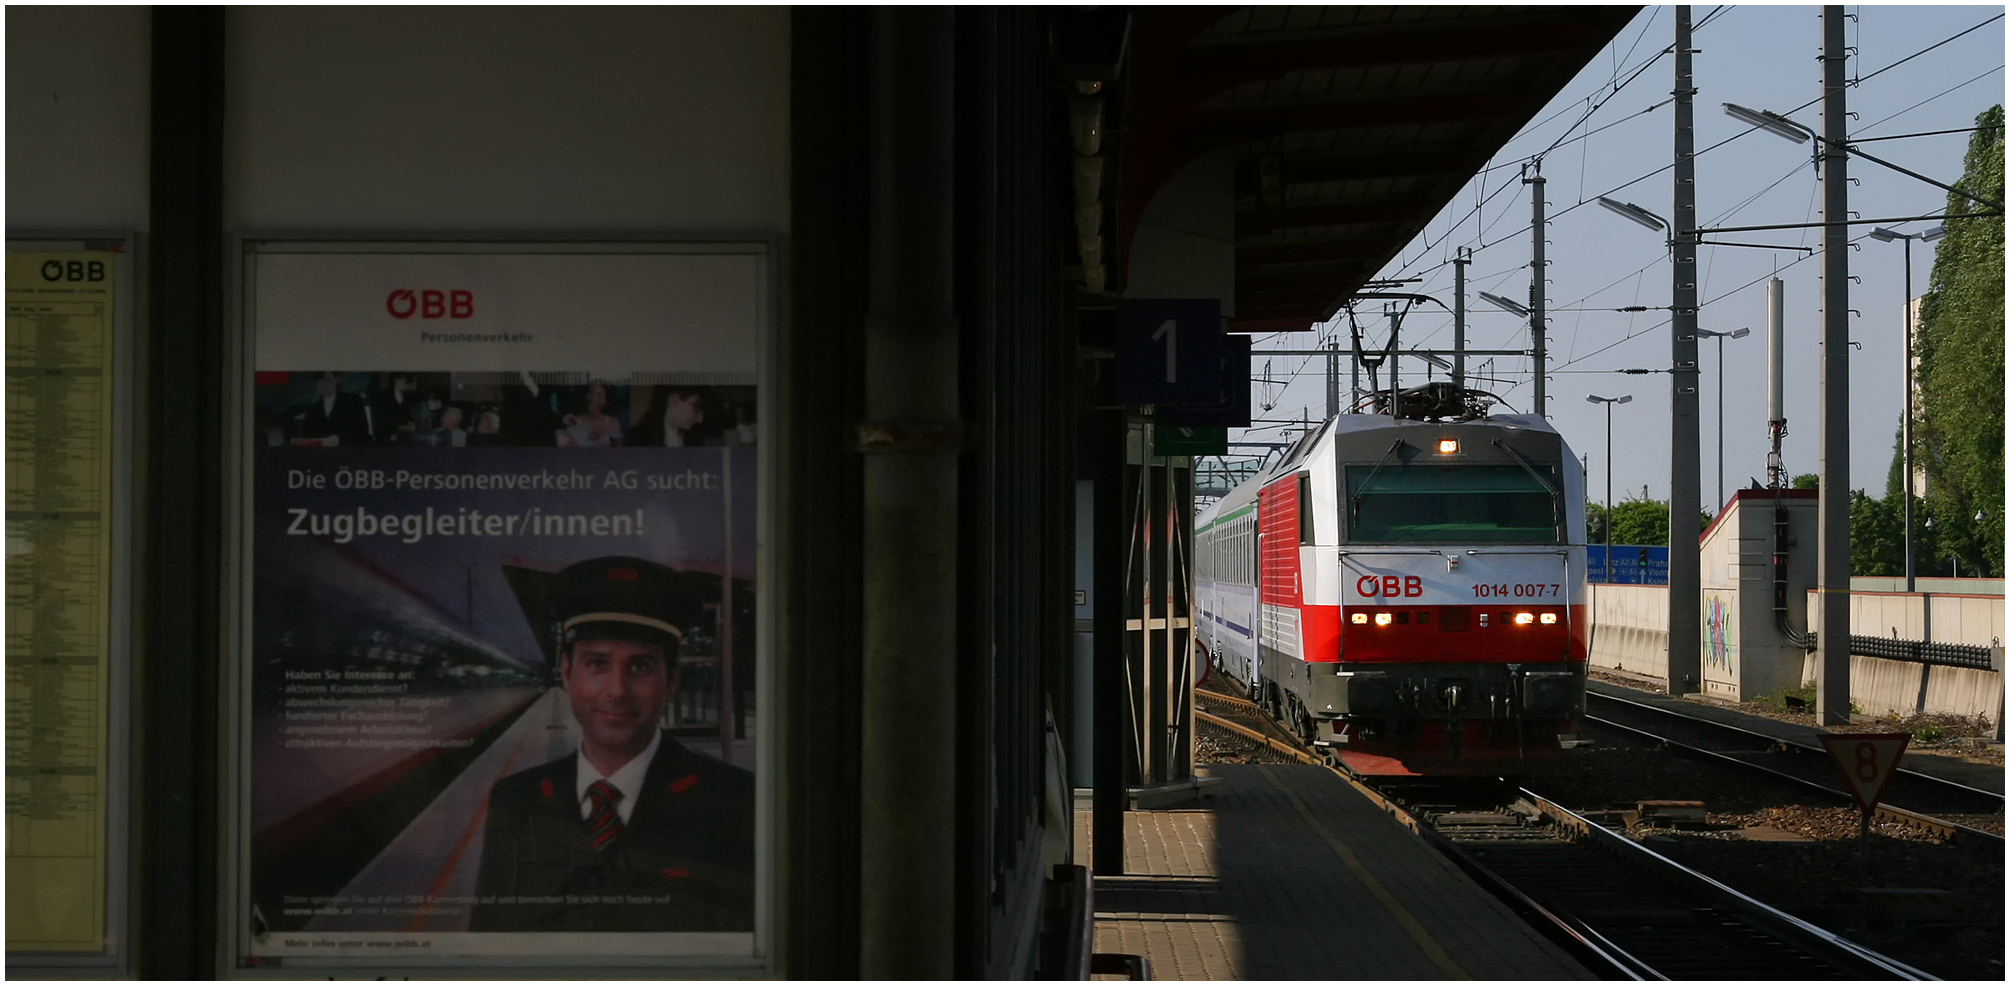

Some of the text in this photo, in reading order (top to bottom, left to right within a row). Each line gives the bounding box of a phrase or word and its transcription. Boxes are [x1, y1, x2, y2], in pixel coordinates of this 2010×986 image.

[42, 259, 105, 282] ÖBB
[386, 288, 475, 320] ÖBB
[420, 331, 534, 344] Personenverkehr
[1151, 319, 1177, 384] 1
[287, 465, 718, 490] Die ÖBB-Personenverkehr AG sucht:
[286, 506, 645, 544] Zugbegleiter/innen!
[1356, 575, 1561, 598] ÖBB 1014 007-7
[285, 670, 321, 680] Haben
[324, 670, 341, 680] Sie
[1855, 741, 1879, 784] 8
